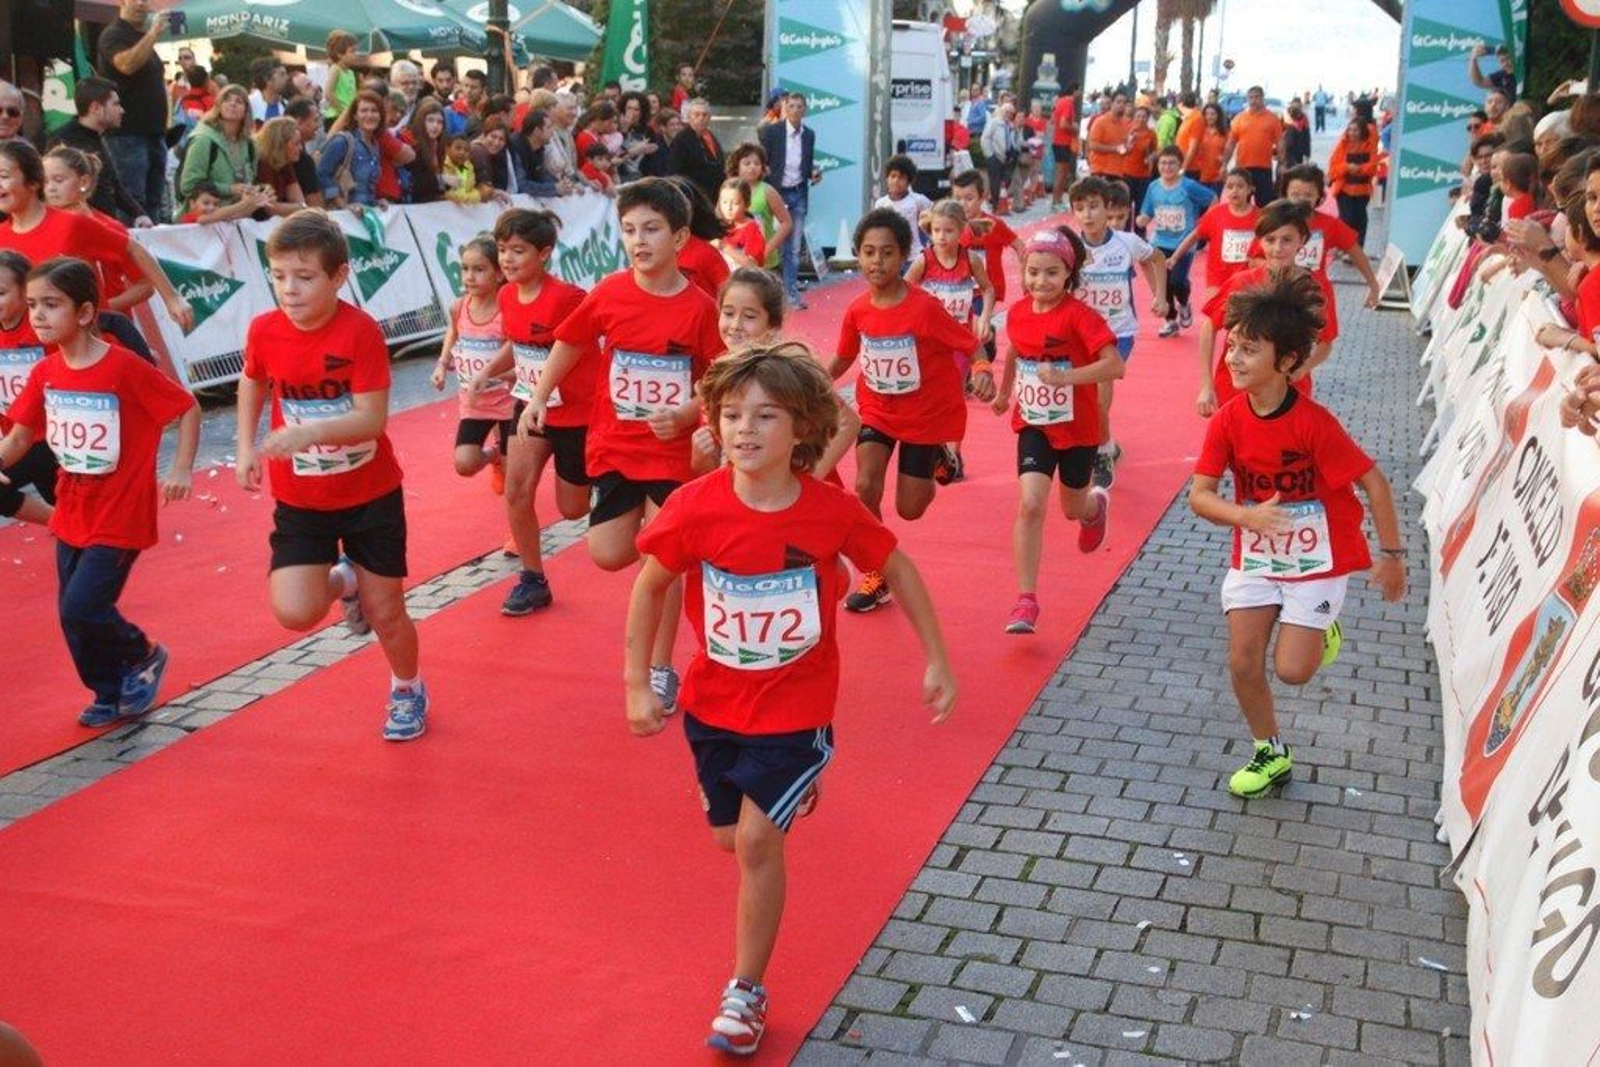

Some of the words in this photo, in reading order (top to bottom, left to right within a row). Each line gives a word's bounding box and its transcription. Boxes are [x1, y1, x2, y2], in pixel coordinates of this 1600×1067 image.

[206, 11, 290, 30] MONDARIZ
[864, 357, 911, 377] 2176
[615, 377, 680, 405] 2132
[49, 420, 108, 450] 2192
[1249, 527, 1319, 555] 2179
[711, 603, 805, 643] 2172
